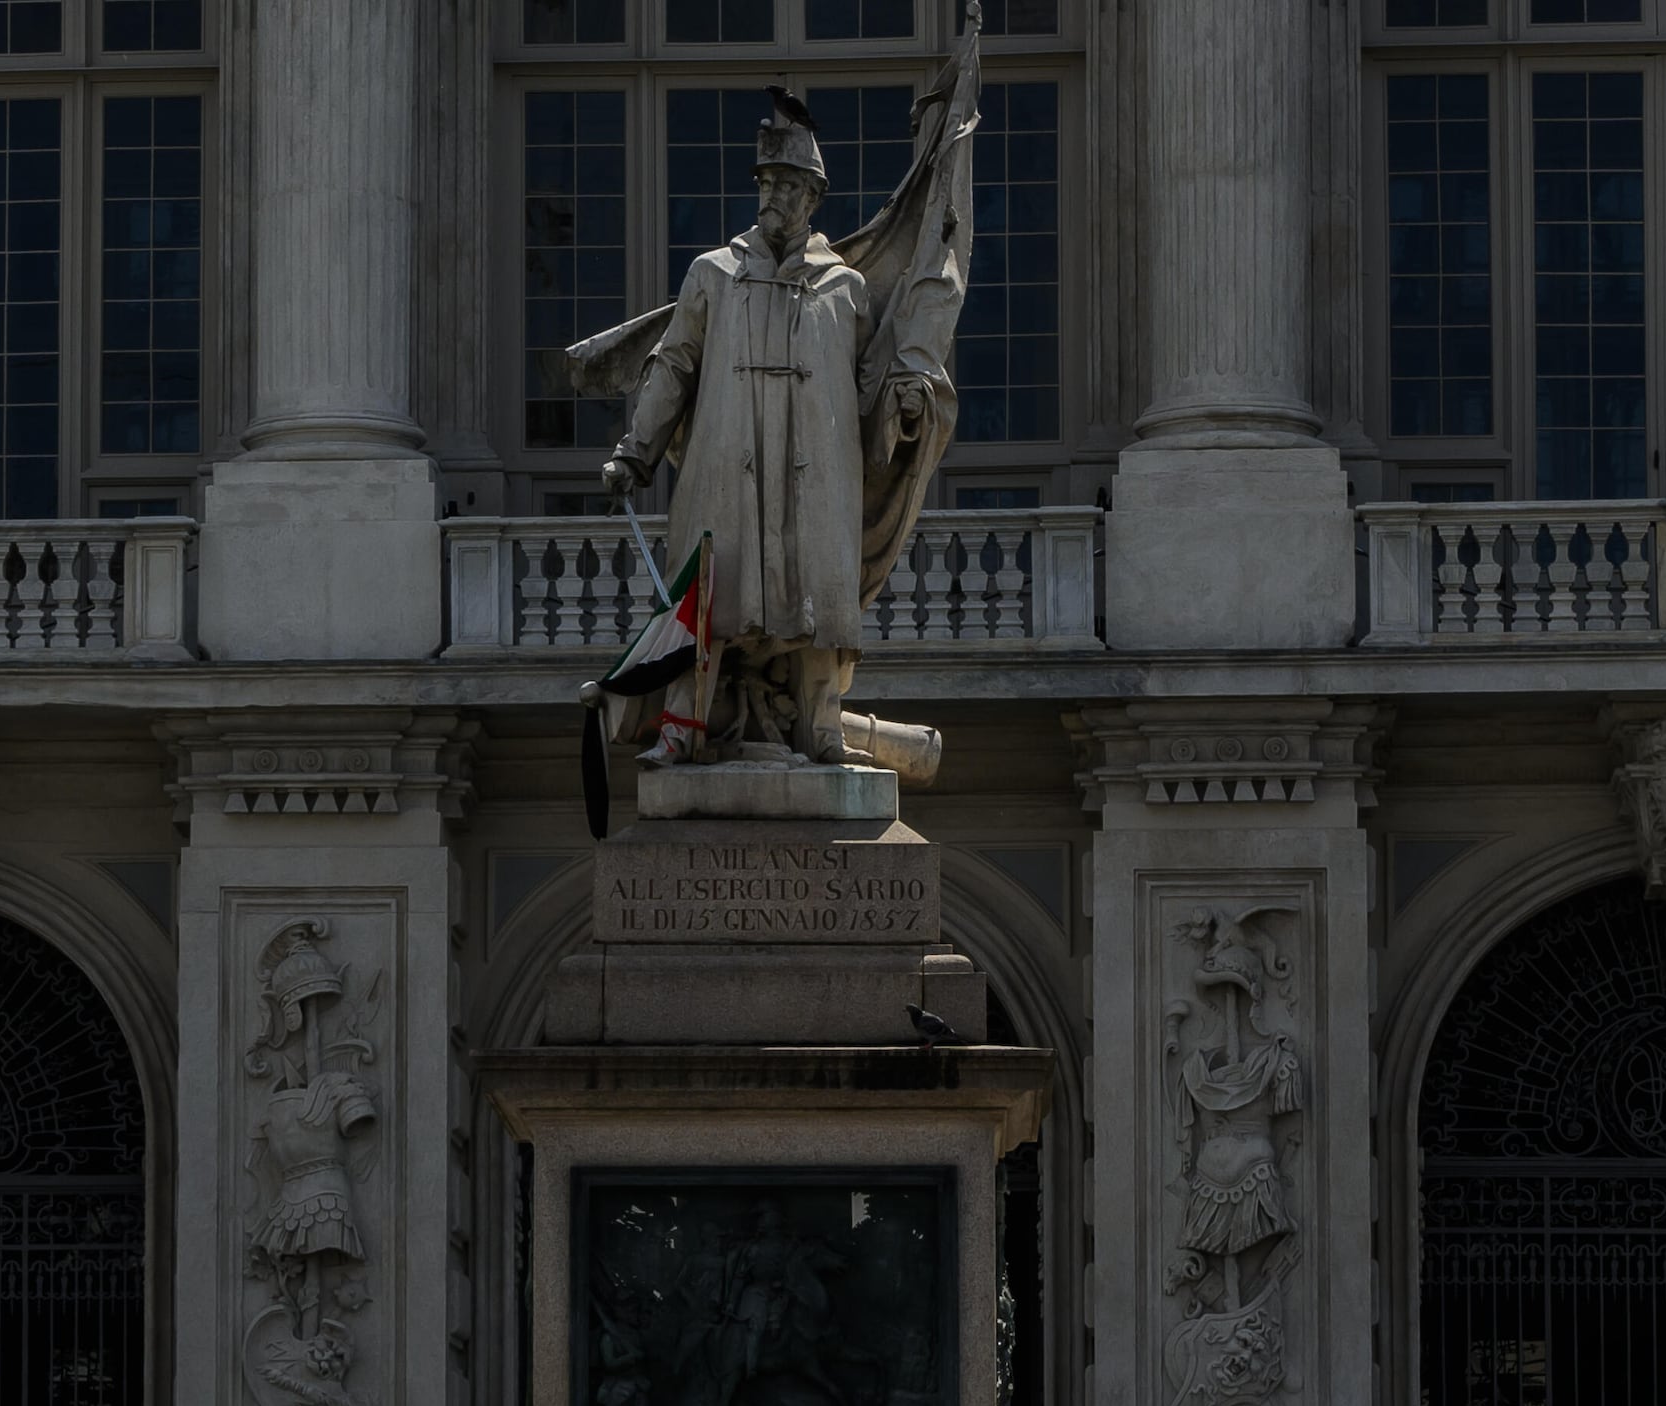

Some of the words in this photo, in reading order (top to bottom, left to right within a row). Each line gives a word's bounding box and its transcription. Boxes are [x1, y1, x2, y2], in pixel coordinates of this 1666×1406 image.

[709, 848, 849, 870] MILANESI
[677, 877, 809, 902] ESERCITO
[824, 877, 925, 902] SARDO
[621, 909, 644, 931] IL
[723, 908, 837, 931] GENNAIO
